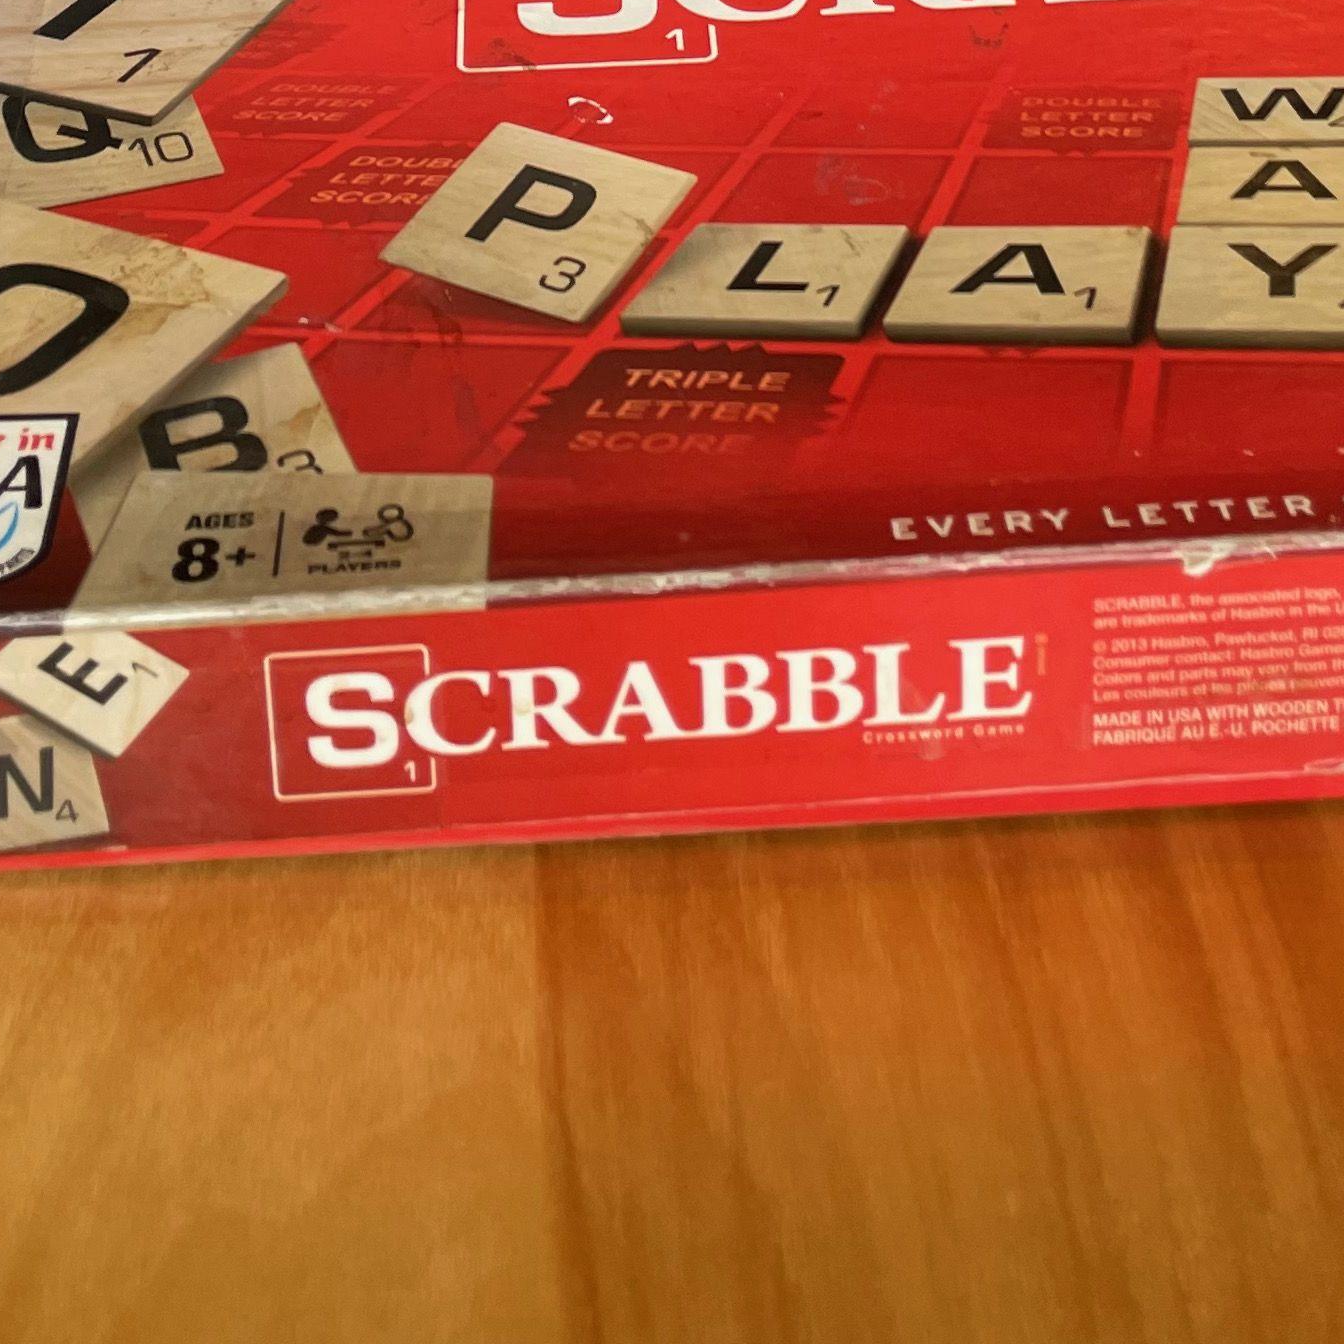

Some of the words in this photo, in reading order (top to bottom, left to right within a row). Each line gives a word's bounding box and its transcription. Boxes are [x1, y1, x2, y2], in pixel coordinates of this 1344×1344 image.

[117, 48, 162, 83] 1
[232, 110, 350, 122] SCORE
[251, 97, 375, 108] LETTER
[2, 93, 124, 163] Q
[126, 129, 194, 168] 10
[1020, 126, 1144, 138] SCORE
[329, 172, 448, 186] LETTE
[1230, 160, 1337, 200] A
[464, 163, 598, 244] P
[538, 256, 588, 295] 3
[726, 241, 809, 293] L
[815, 285, 841, 308] 1
[949, 243, 1070, 296] A
[1072, 286, 1099, 311] 1
[1228, 243, 1339, 298] Y
[624, 368, 791, 392] TRIPLE
[585, 398, 781, 424] LETTER
[18, 427, 55, 451] in
[137, 396, 269, 473] B
[567, 429, 750, 455] SCORE
[184, 512, 255, 531] AGES
[891, 507, 1072, 542] EVERY
[1102, 493, 1316, 528] LETTER
[171, 537, 257, 583] 8+
[307, 559, 402, 575] PLAYERS
[37, 642, 129, 706] E
[131, 660, 160, 680] 1
[306, 634, 1033, 771] SCRABBLE
[1093, 710, 1141, 728] MADE
[1147, 709, 1163, 725] IN
[1168, 707, 1202, 724] USA
[1206, 704, 1248, 721] WITH
[1253, 699, 1328, 719] WOODEN
[862, 725, 965, 745] Crossword
[972, 722, 1027, 738] Game
[54, 798, 80, 824] 4
